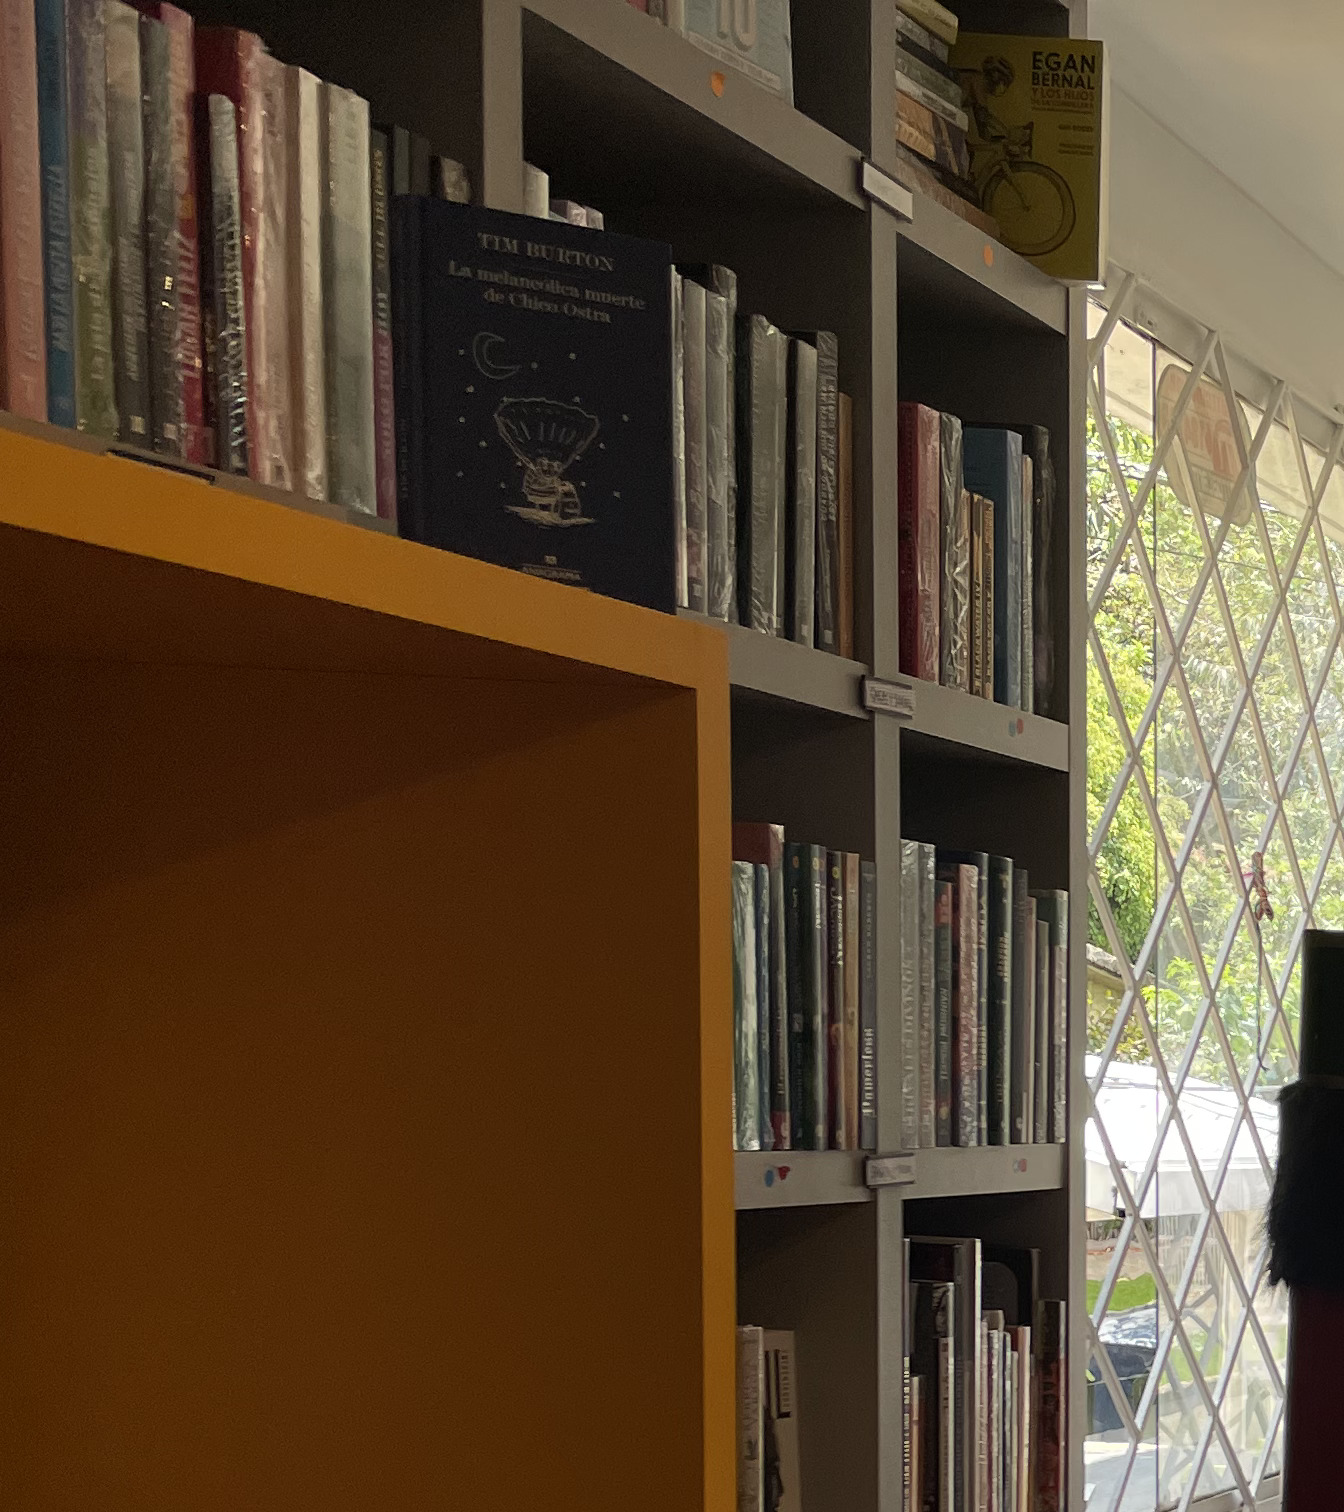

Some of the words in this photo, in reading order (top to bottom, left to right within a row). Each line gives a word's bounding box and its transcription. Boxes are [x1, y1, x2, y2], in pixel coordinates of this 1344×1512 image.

[1032, 51, 1095, 74] EGAN
[1032, 71, 1095, 90] BERNAL
[476, 232, 518, 255] TIM
[526, 241, 616, 272] BURTON
[585, 288, 647, 311] muerte
[563, 303, 612, 325] Ostra
